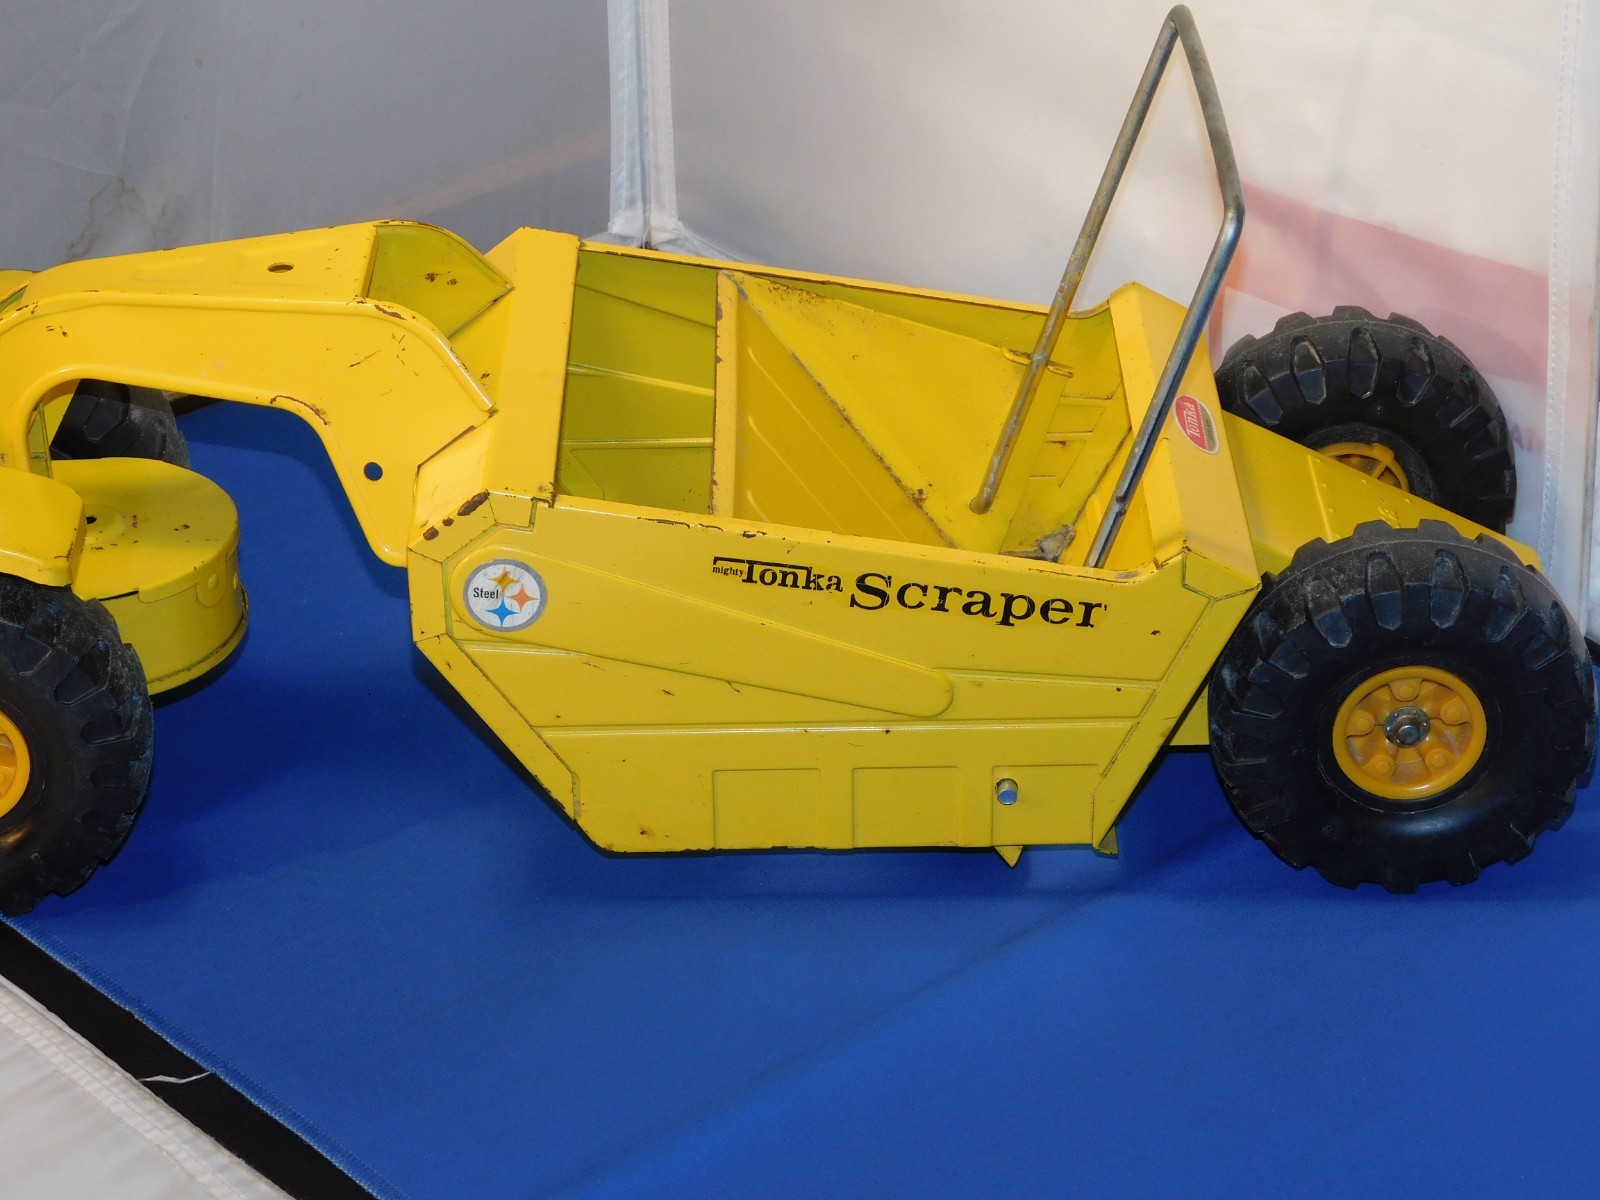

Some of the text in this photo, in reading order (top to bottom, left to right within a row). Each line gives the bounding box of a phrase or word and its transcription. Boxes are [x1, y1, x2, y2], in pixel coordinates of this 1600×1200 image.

[1183, 402, 1201, 438] Tonka
[473, 587, 499, 599] Steel
[712, 556, 1107, 628] mighty Tonka Scraper
